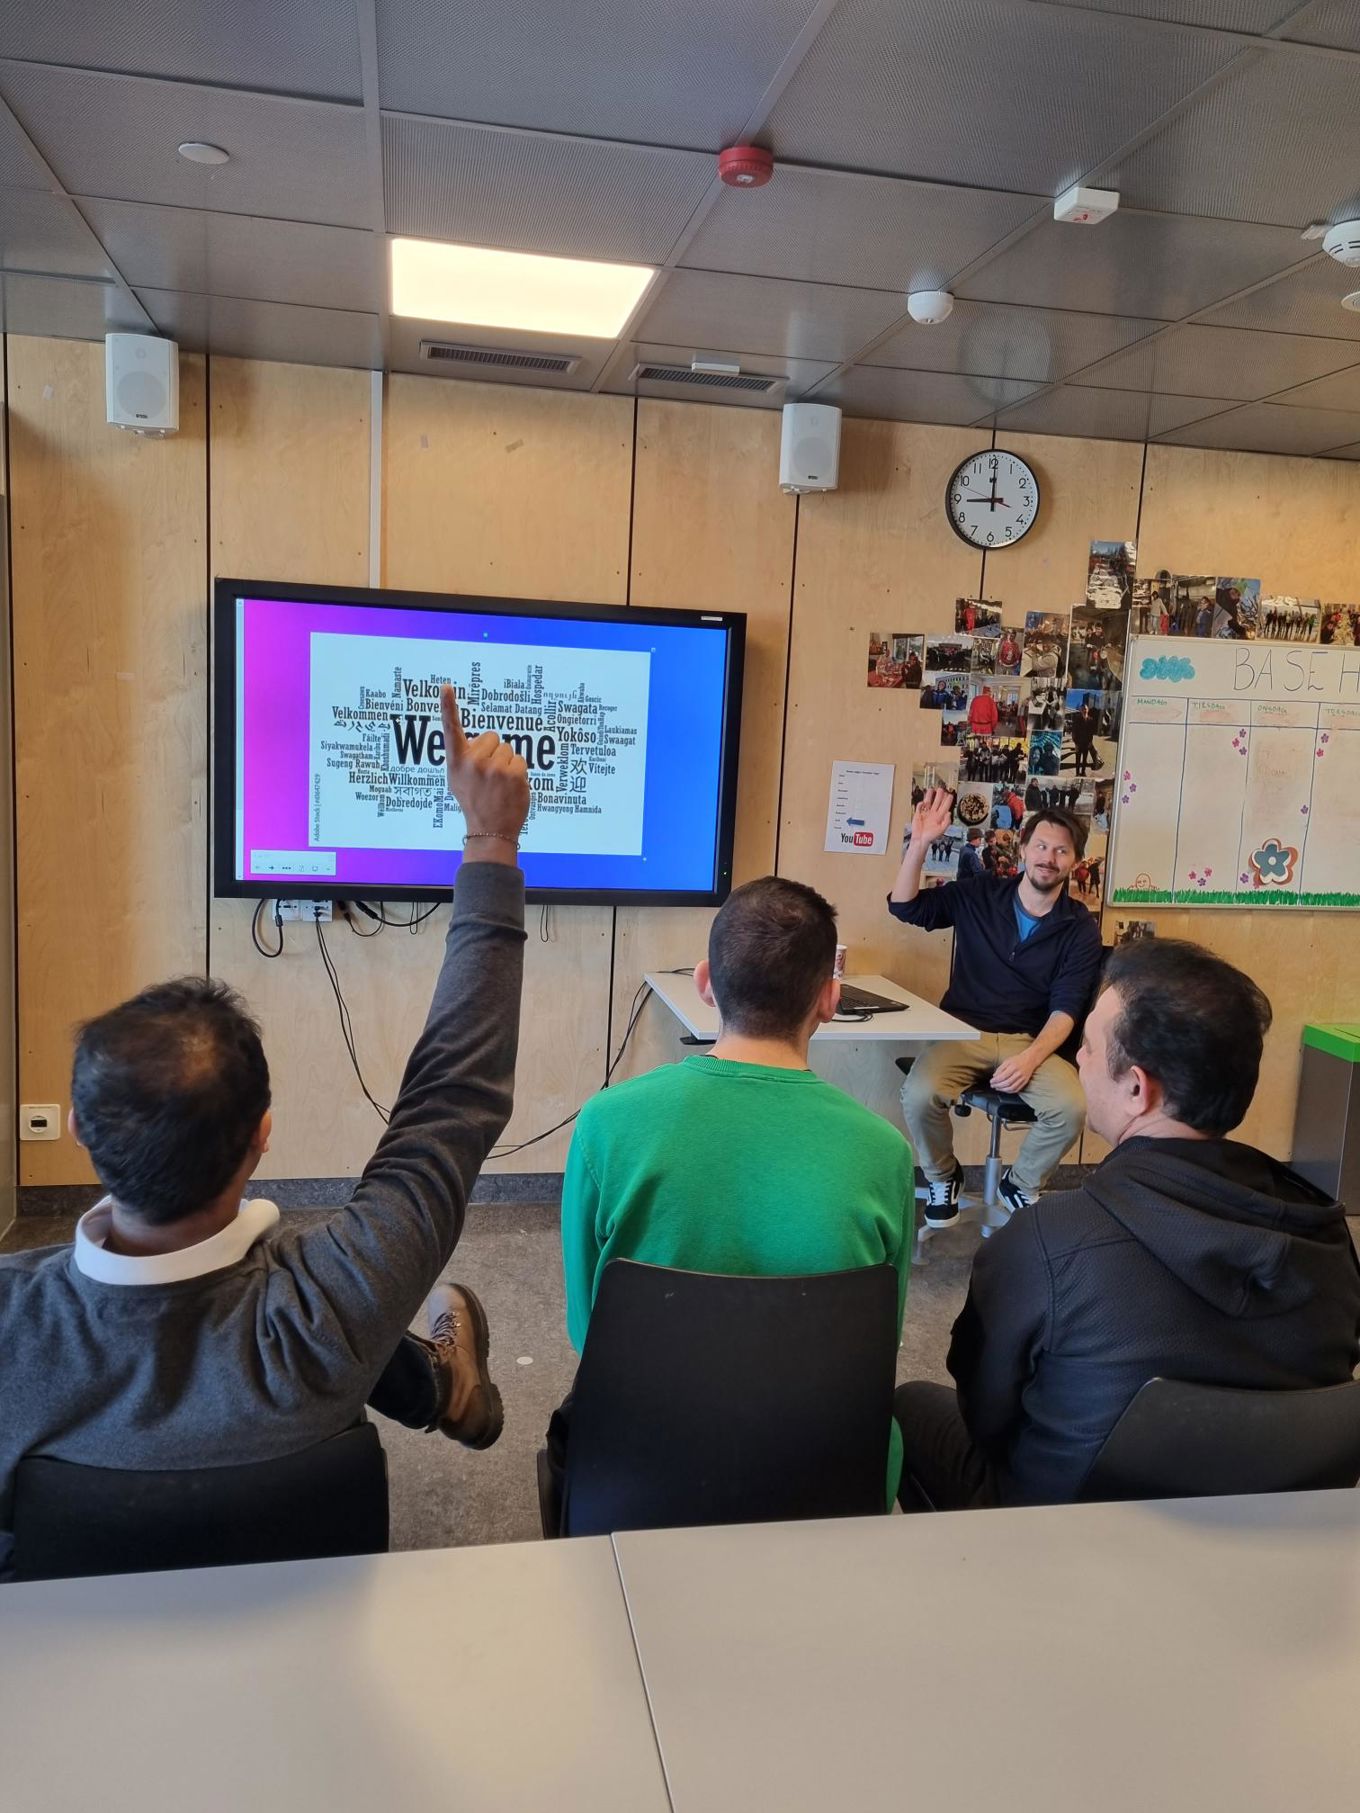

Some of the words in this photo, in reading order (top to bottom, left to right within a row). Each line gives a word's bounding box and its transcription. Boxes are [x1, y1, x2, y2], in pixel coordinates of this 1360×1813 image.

[974, 463, 982, 474] 11
[989, 457, 998, 469] 12
[961, 475, 970, 486] 10
[1018, 478, 1026, 488] 2
[954, 494, 961, 504] 9
[1023, 496, 1030, 507] 3
[959, 512, 966, 523] 8
[1016, 514, 1024, 524] 4
[971, 525, 978, 536] 7
[986, 532, 994, 542] 6
[1005, 527, 1012, 537] 5
[1233, 647, 1329, 691] BASE
[391, 666, 402, 699] Namaste
[402, 678, 466, 700] Velkoin
[531, 665, 544, 705] Hospedar
[365, 688, 387, 699] Kaabo
[481, 688, 531, 703] Dobrodošli
[332, 705, 389, 721] Velkommen
[481, 702, 513, 714] Selamat
[515, 703, 543, 717] Datang
[557, 700, 598, 716] Swagata
[460, 707, 544, 731] Bienvenue
[543, 700, 557, 733] Acollir
[557, 713, 597, 726] Ongietorri
[556, 726, 597, 744] Yokôso
[603, 734, 636, 747] Swaagat
[389, 713, 556, 771] Weme
[570, 743, 617, 757] Tervetuloa
[326, 757, 353, 770] Sugeng
[355, 759, 381, 770] Rawuh
[354, 791, 379, 802] Woezor
[385, 795, 433, 811] Dobredojde
[537, 791, 587, 806] Bonavinuta
